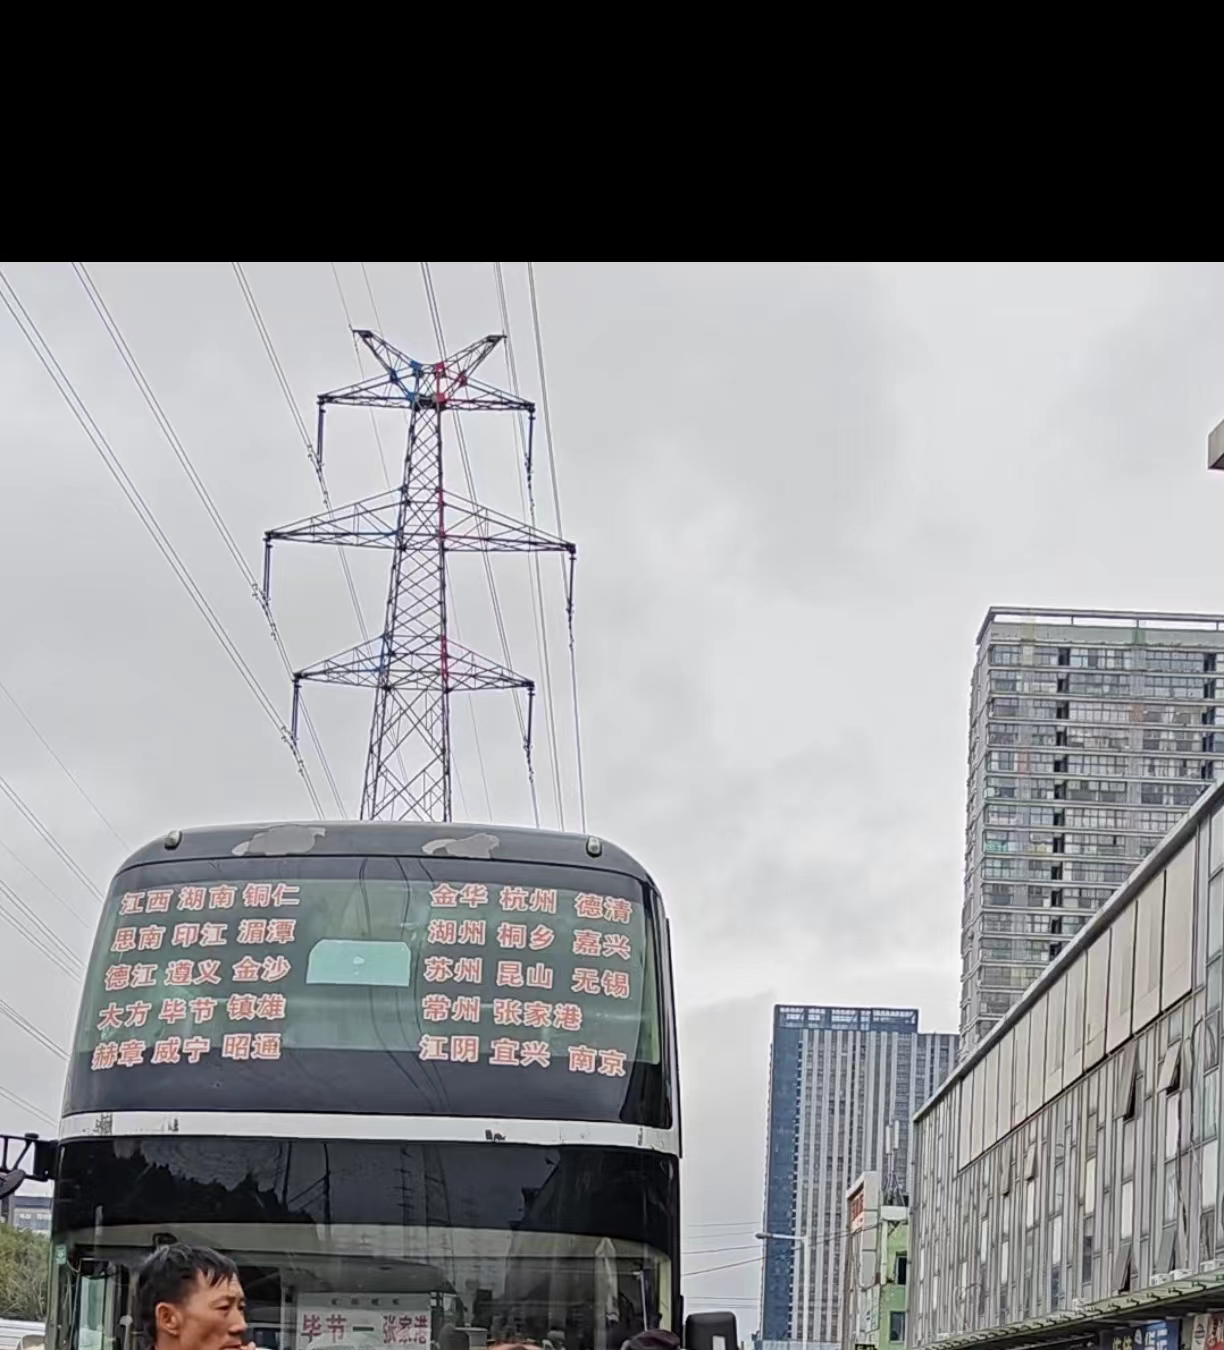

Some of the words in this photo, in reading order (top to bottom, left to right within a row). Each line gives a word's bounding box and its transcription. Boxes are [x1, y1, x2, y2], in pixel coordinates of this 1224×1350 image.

[119, 889, 173, 915] 江西
[178, 884, 236, 911] 湖南
[242, 883, 300, 908] 铜仁
[430, 883, 489, 908] 金华
[499, 885, 557, 913] 杭州
[575, 892, 633, 923] 德清
[111, 925, 165, 952] 思南
[171, 921, 227, 948] 印江
[237, 918, 296, 944] 湄潭
[427, 920, 486, 945] 湖州
[497, 922, 555, 950] 桐乡
[572, 929, 631, 960] 嘉兴
[104, 963, 158, 991] 德江
[164, 959, 221, 986] 遵义
[232, 955, 291, 983] 金沙
[424, 956, 483, 983] 苏州
[496, 960, 553, 989] 昆山
[571, 967, 630, 999] 无锡
[97, 1001, 152, 1030] 大方
[159, 997, 217, 1023] 毕节
[227, 993, 287, 1020] 镇雄
[422, 994, 481, 1022] 常州
[493, 999, 582, 1031] 张家港
[90, 1040, 146, 1071] 赫章
[150, 1036, 210, 1063] 威宁
[222, 1033, 281, 1060] 昭通
[419, 1034, 480, 1062] 江阴
[489, 1038, 551, 1067] 宜兴
[568, 1045, 628, 1077] 南京
